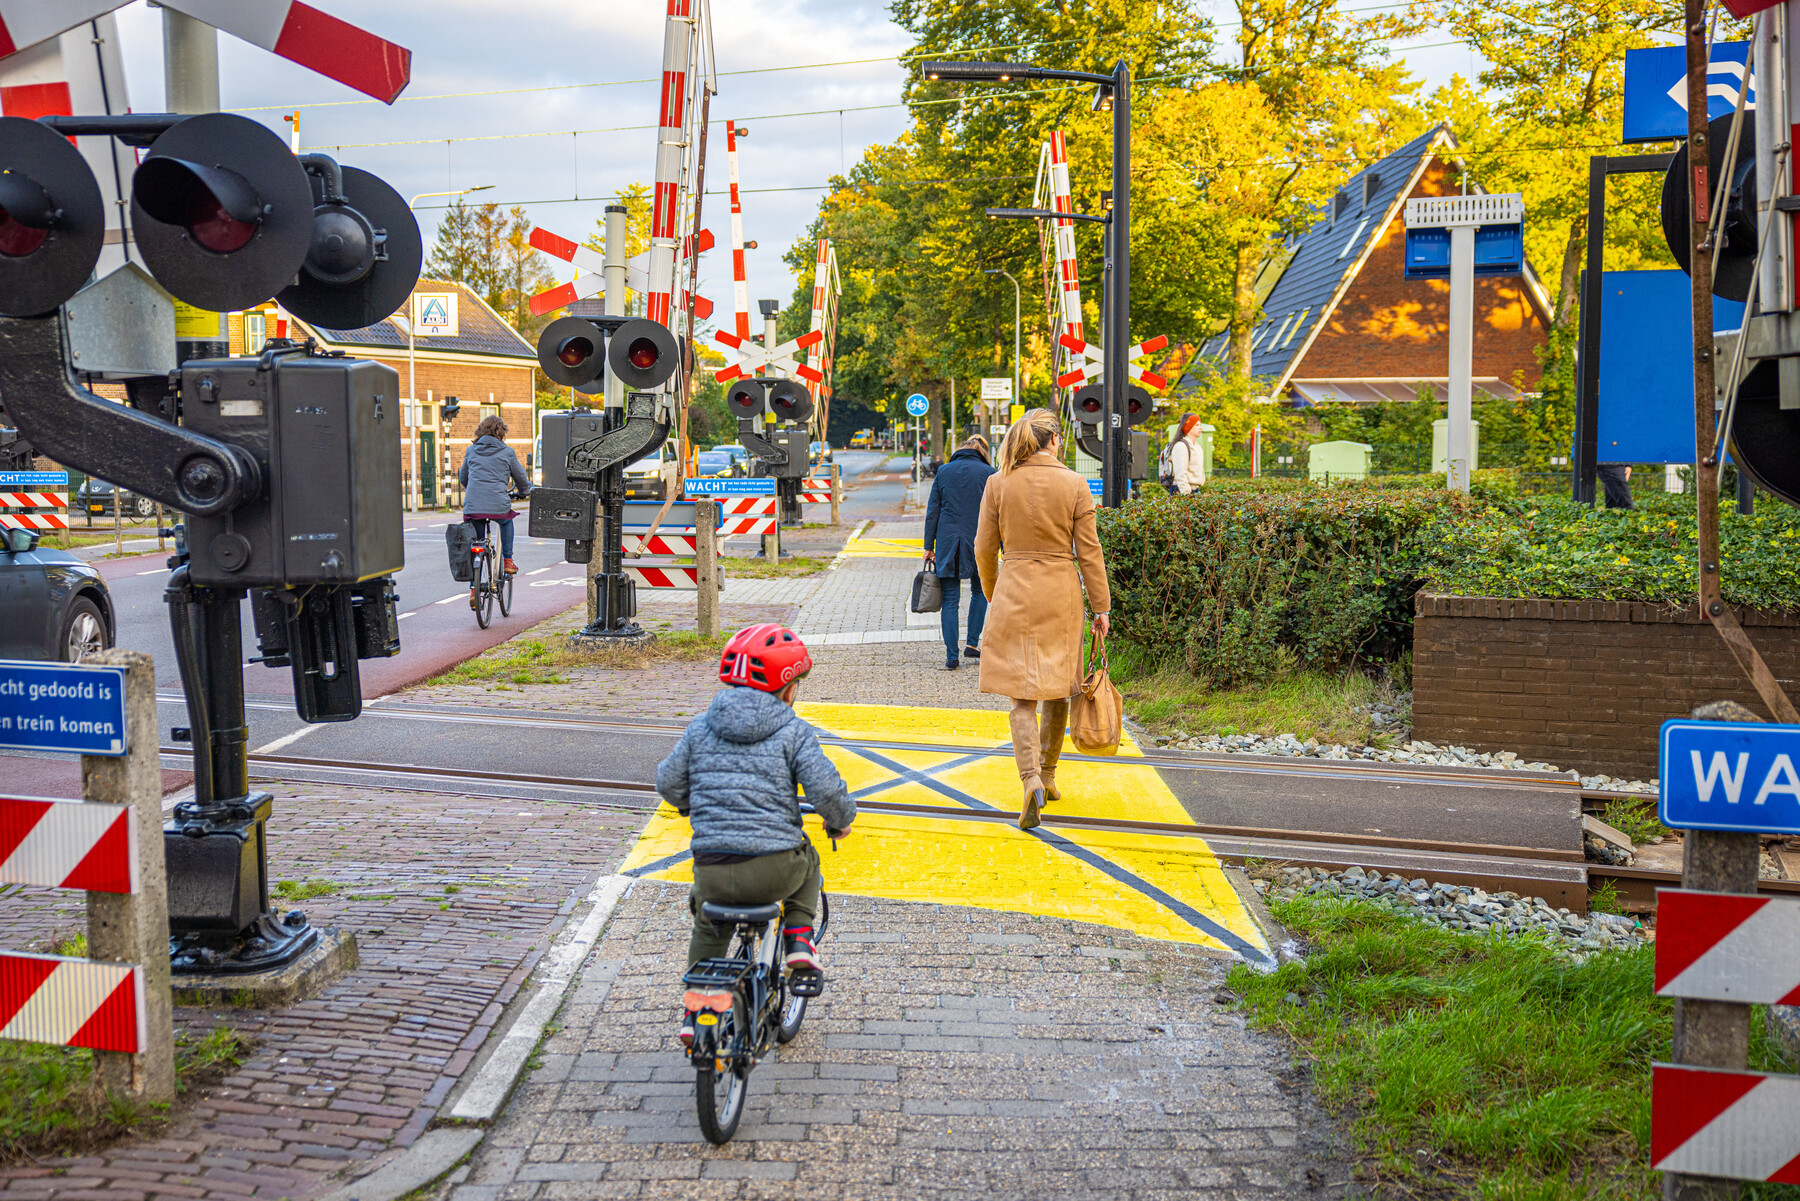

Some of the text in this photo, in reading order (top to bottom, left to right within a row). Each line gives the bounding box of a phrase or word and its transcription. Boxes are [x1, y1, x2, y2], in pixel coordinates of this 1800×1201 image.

[424, 316, 445, 324] ALDI
[685, 481, 727, 492] WACHT
[28, 680, 94, 701] gedoofd
[98, 682, 112, 700] is
[17, 714, 55, 732] trein
[1690, 750, 1800, 805] WA
